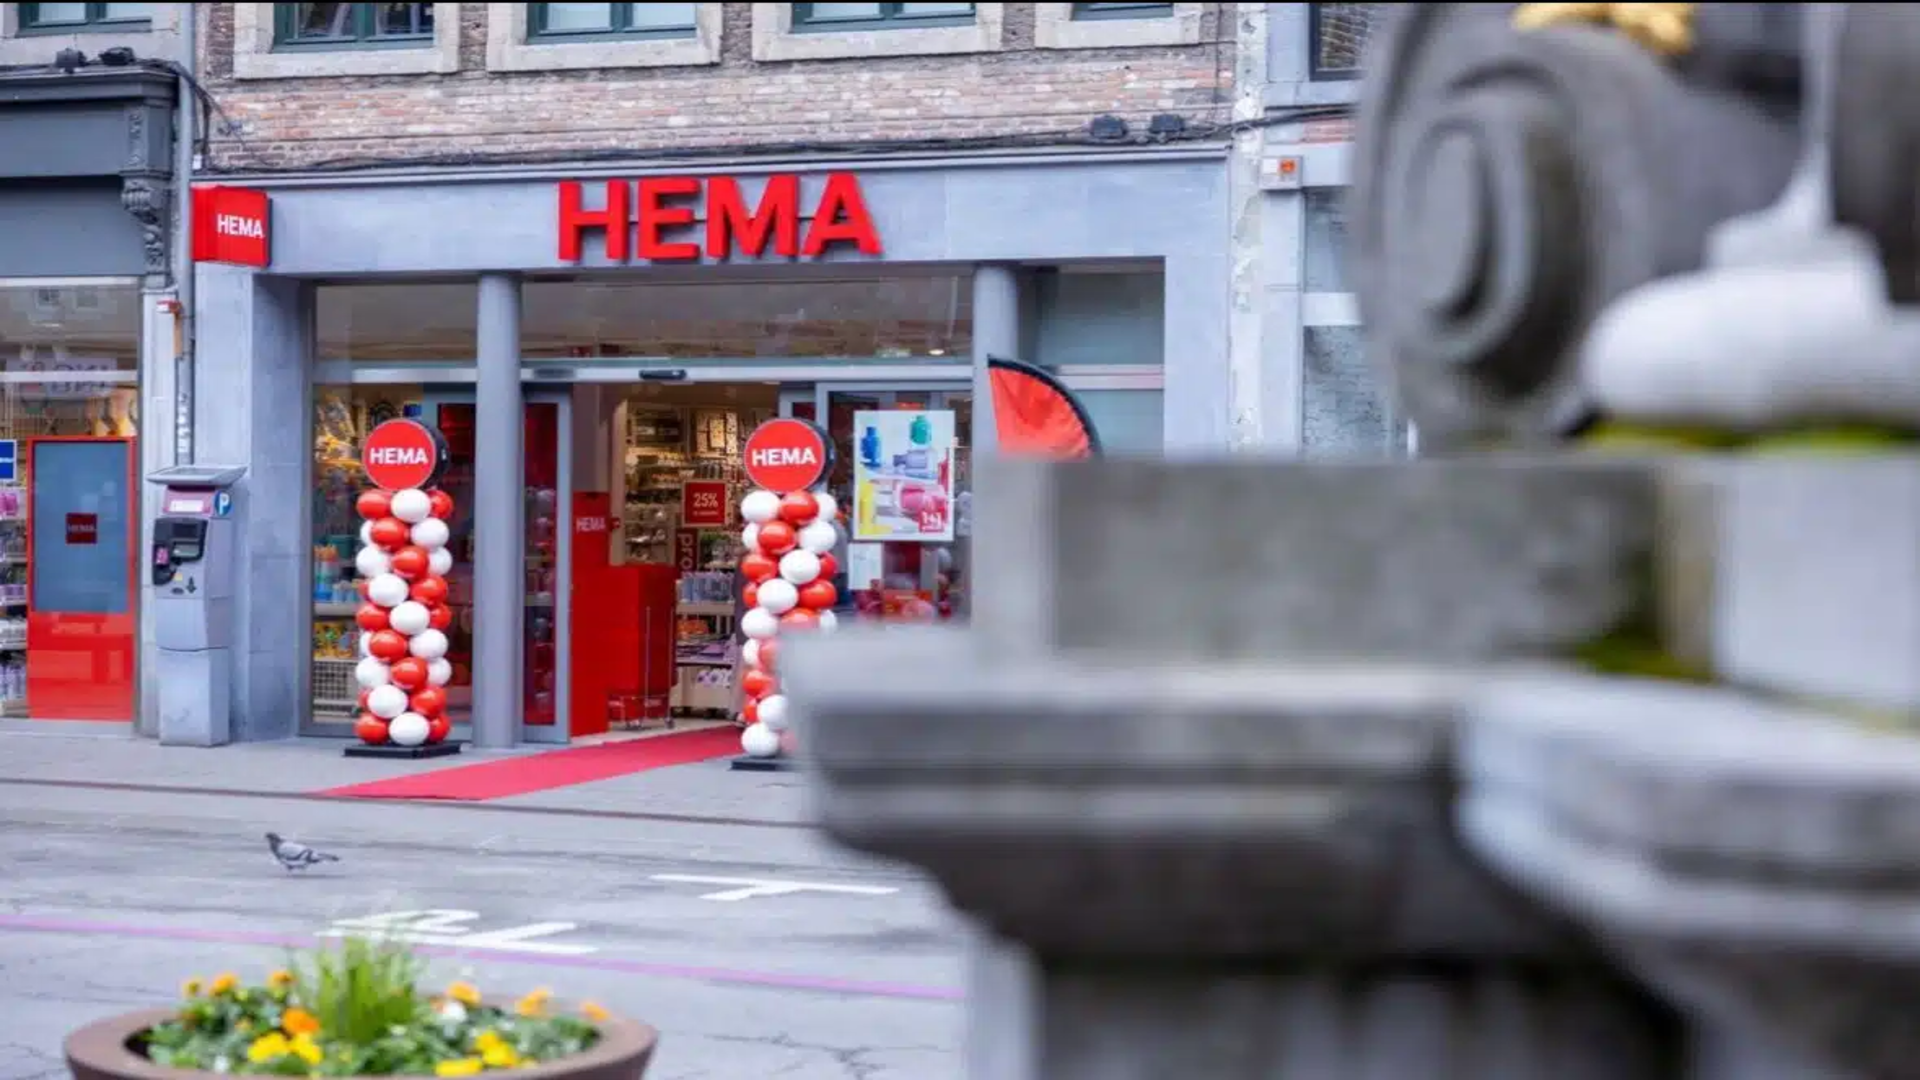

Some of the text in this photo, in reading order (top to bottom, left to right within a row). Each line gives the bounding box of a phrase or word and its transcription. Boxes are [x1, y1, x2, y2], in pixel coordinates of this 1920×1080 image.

[216, 213, 265, 238] HEMA
[558, 171, 883, 261] HEMA
[369, 447, 429, 465] HEMA
[752, 446, 817, 467] HEMA
[219, 492, 231, 516] P
[693, 492, 719, 508] 25%
[576, 517, 606, 532] HEMA
